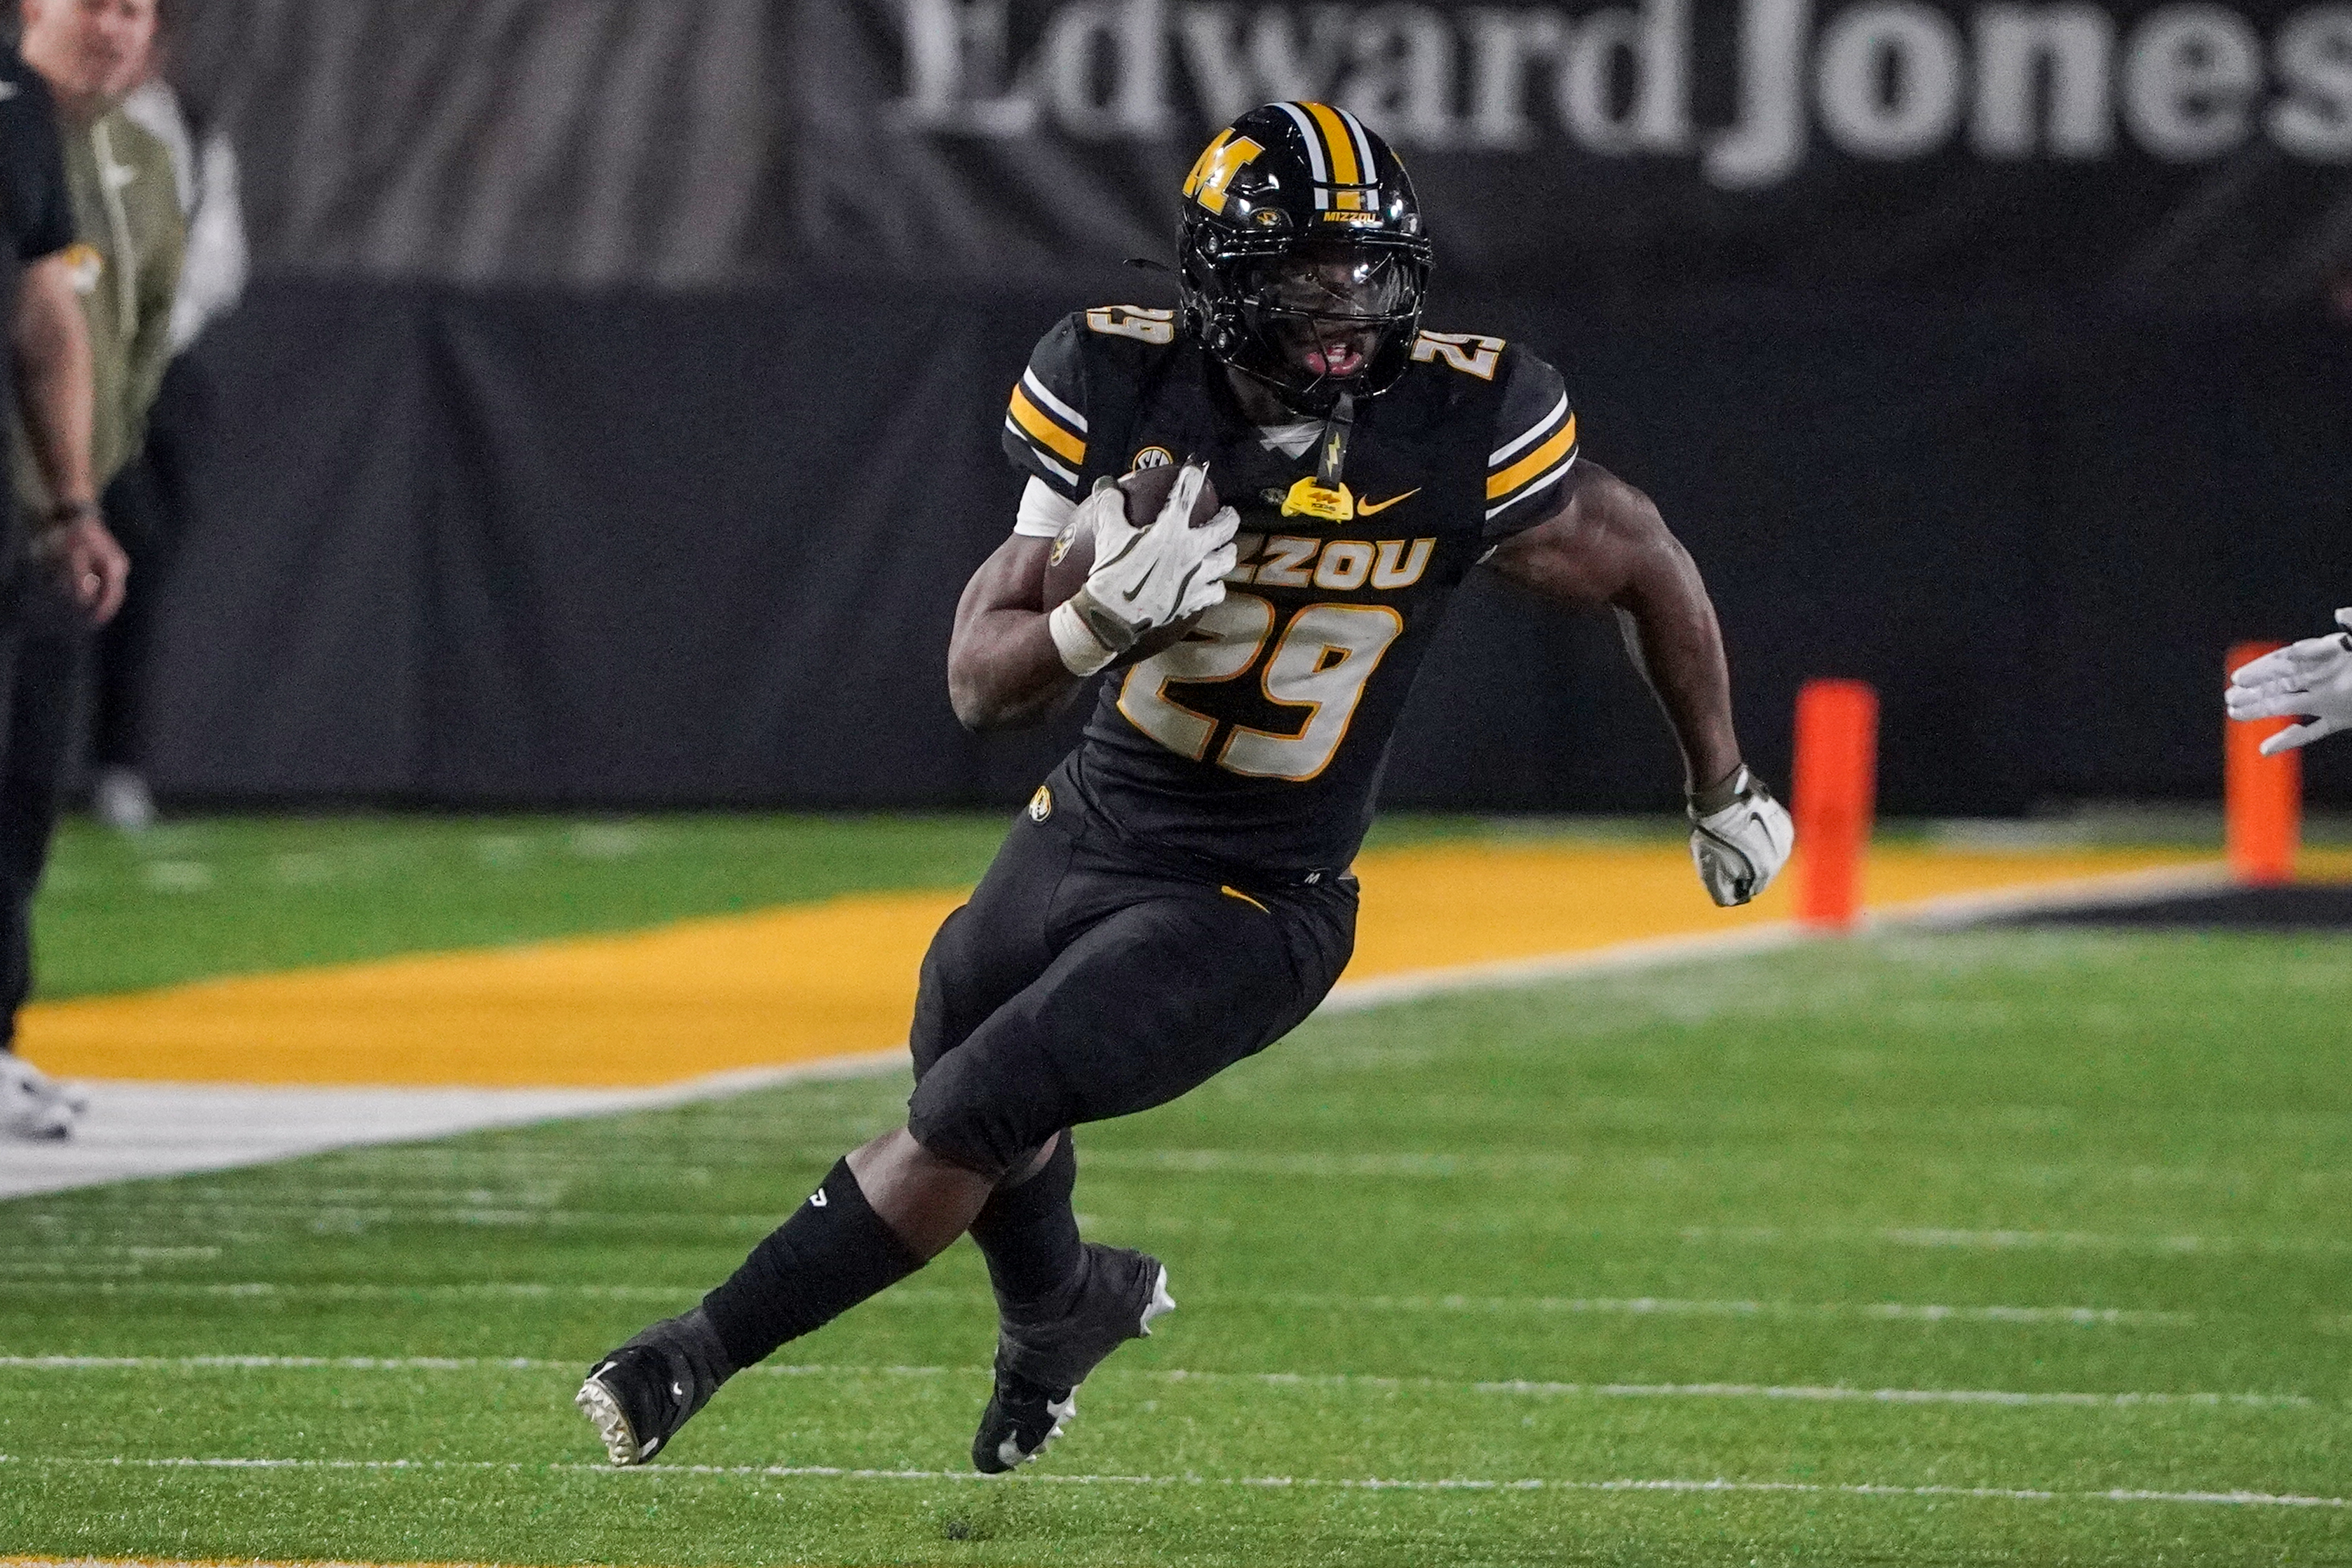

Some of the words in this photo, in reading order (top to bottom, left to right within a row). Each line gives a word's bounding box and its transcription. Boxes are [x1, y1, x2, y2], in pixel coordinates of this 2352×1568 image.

[889, 0, 1689, 151] Edward
[1700, 0, 2352, 187] Jones
[1323, 211, 1377, 223] MIZZOU
[1116, 591, 1403, 782] 29
